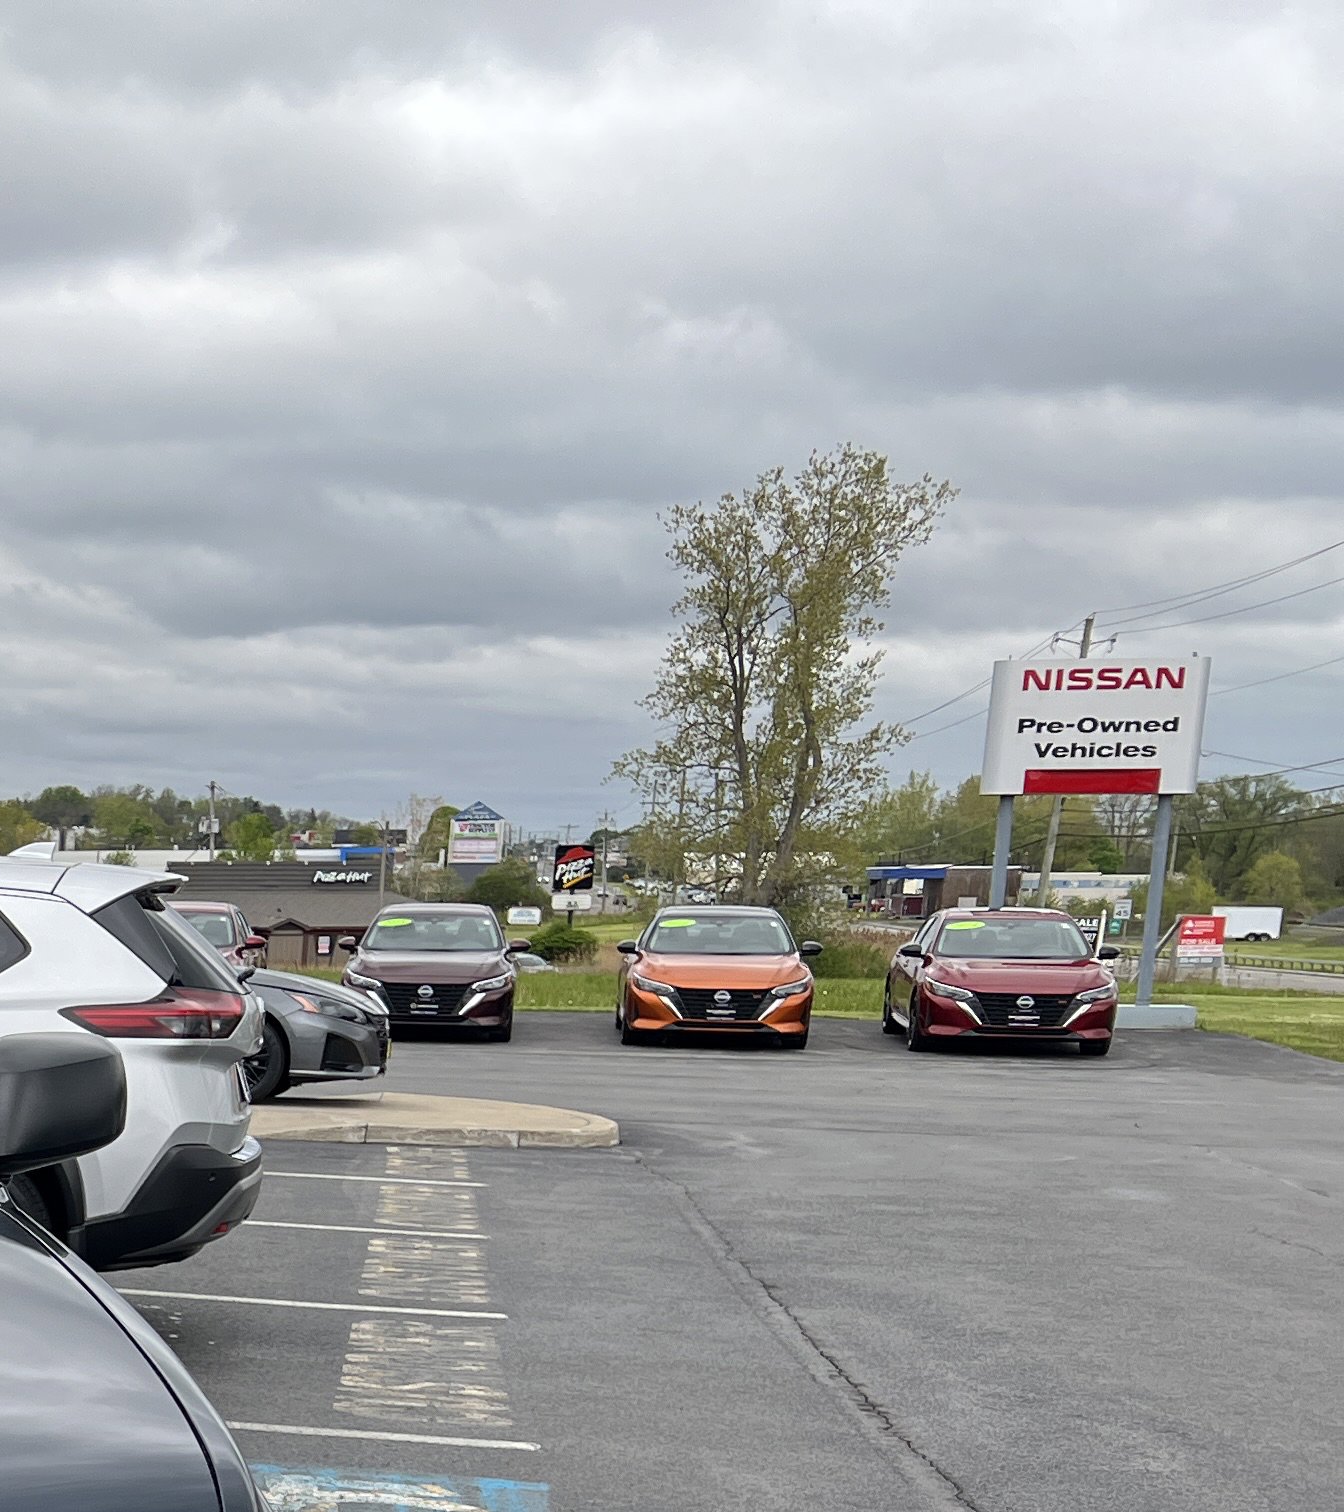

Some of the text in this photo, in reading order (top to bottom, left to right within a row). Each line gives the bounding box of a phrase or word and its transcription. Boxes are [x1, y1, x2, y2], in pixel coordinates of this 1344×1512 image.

[1022, 667, 1186, 691] NISSAN
[1017, 716, 1180, 734] Pre-Owned
[1034, 742, 1158, 758] Vehicles
[555, 858, 595, 881] Pizza
[562, 867, 591, 884] Hut
